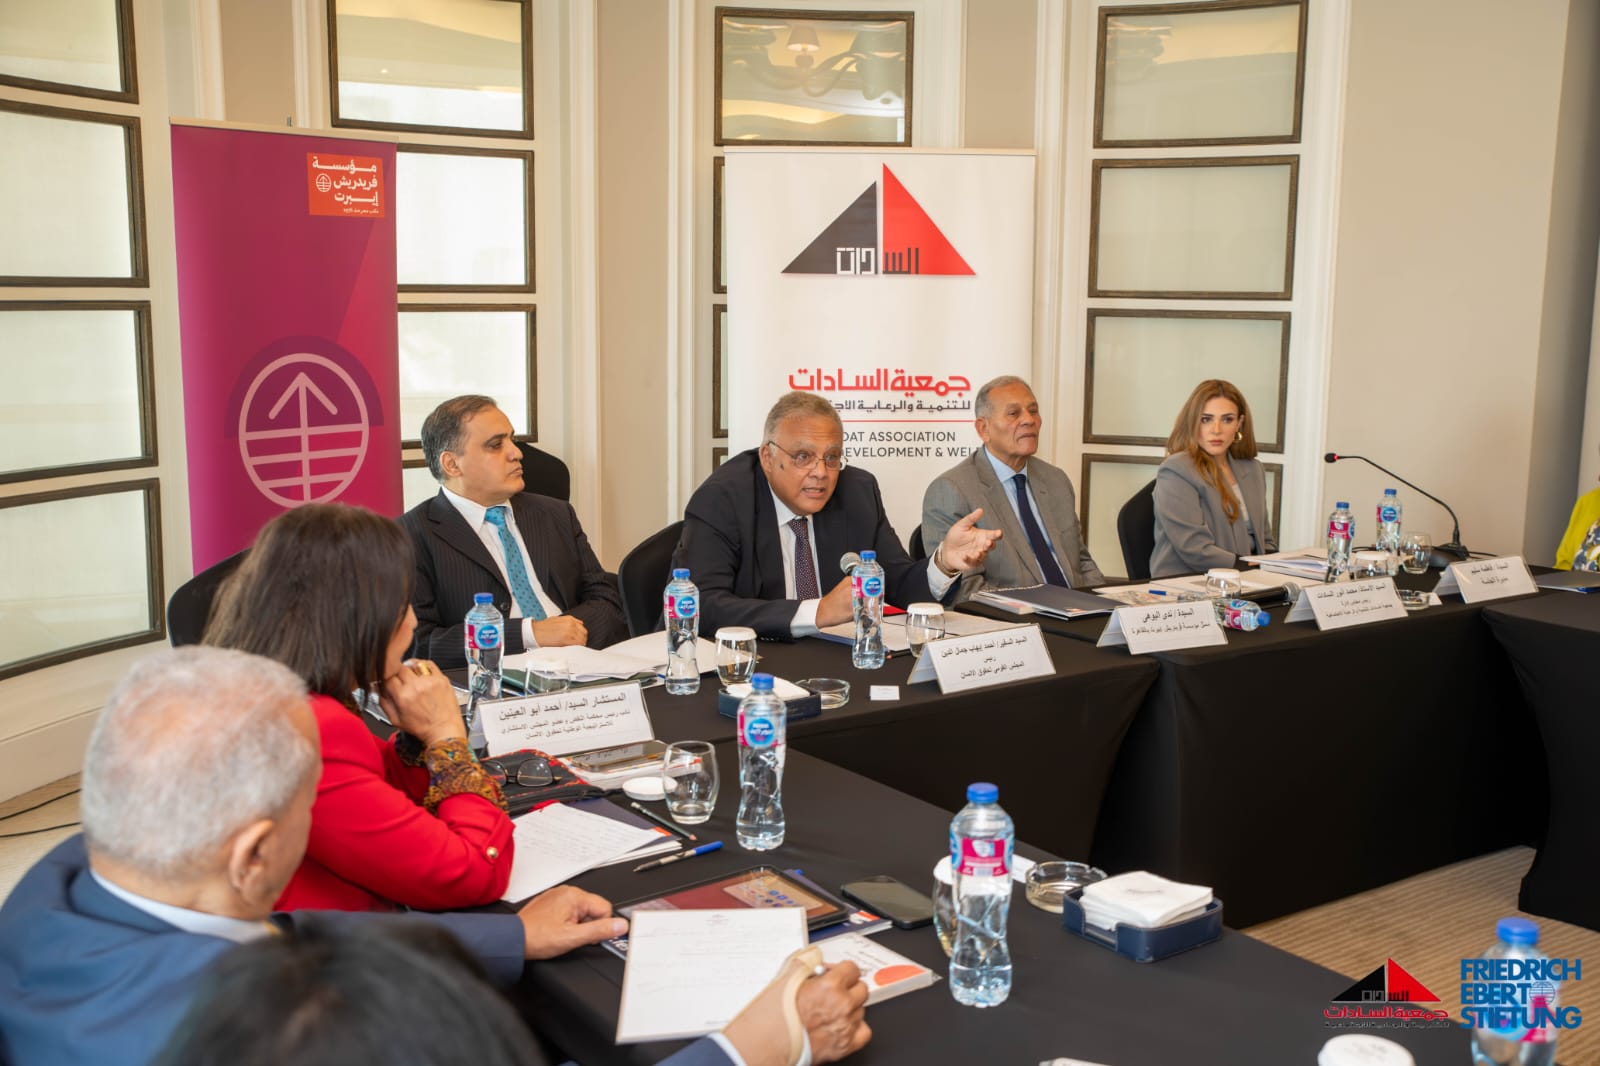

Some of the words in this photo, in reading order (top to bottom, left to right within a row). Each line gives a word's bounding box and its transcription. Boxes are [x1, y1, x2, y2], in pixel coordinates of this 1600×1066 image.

[312, 156, 377, 174] مؤسسة
[333, 175, 378, 191] فريدريش
[789, 368, 889, 391] السادات
[890, 368, 971, 397] جمعية
[857, 400, 913, 413] والرعاية
[916, 400, 971, 413] للتنمية
[843, 431, 865, 442] DAT
[869, 431, 956, 442] ASSOCIATION
[845, 447, 934, 458] EVELOPMENT
[935, 447, 943, 457] &
[592, 692, 626, 708] المستشار
